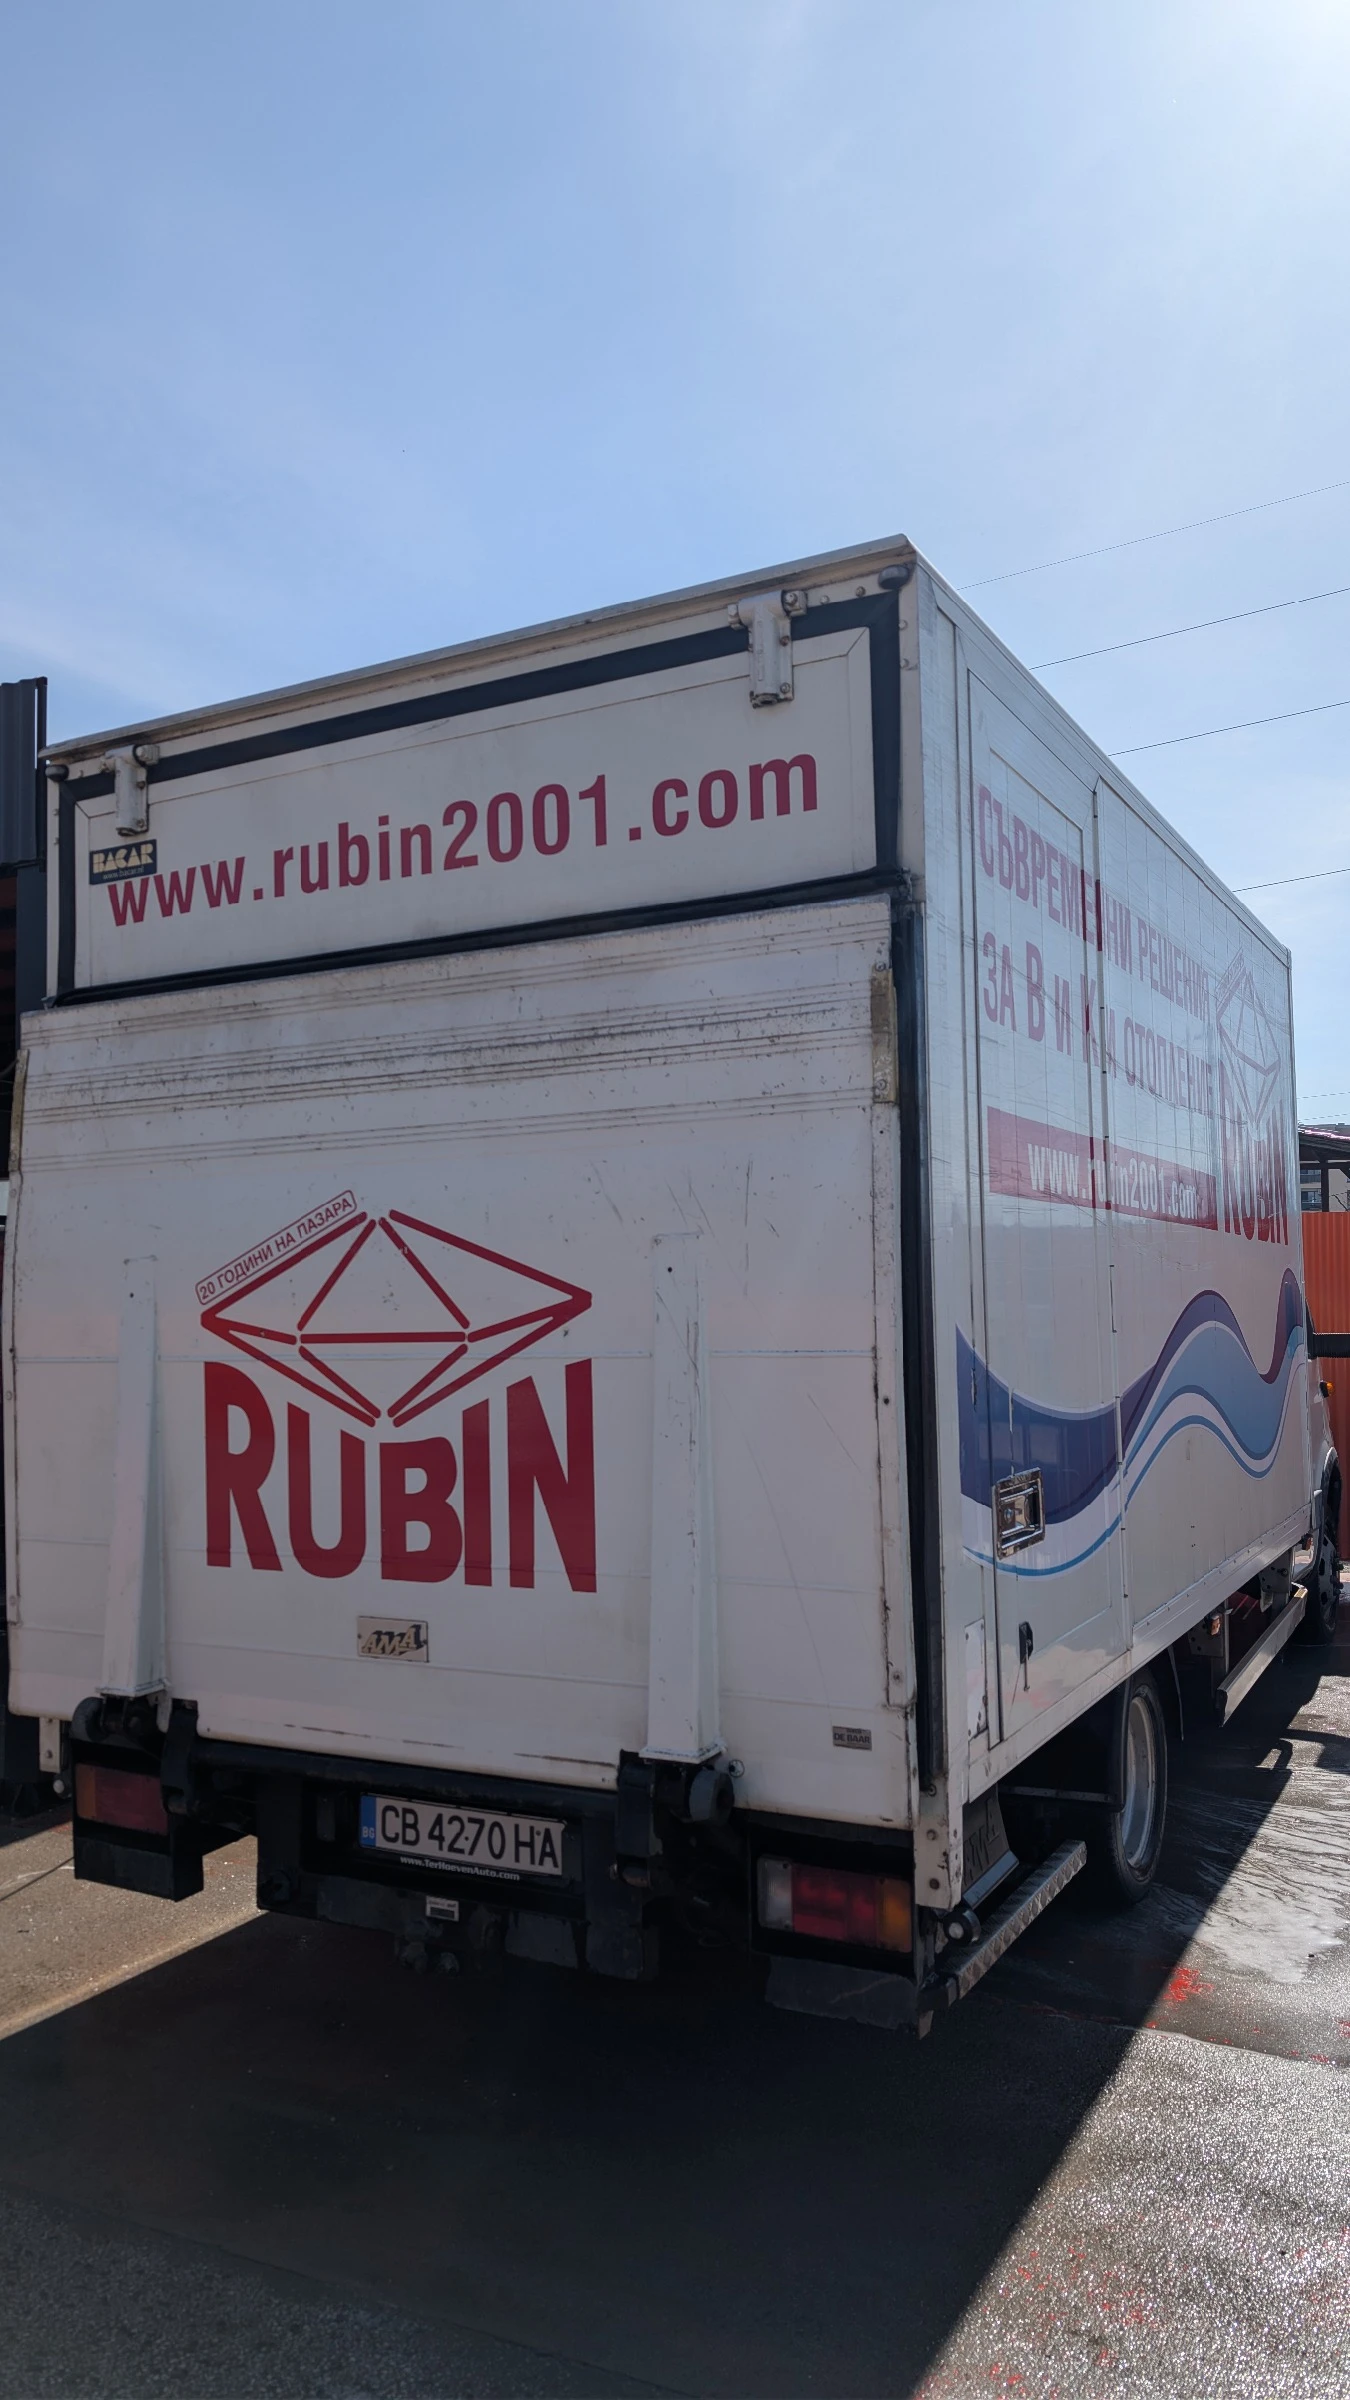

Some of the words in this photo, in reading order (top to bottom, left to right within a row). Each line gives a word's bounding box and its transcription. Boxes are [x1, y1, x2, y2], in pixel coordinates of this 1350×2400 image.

[92, 843, 154, 874] BACAR
[107, 753, 819, 927] www.rubin2001.com
[983, 932, 1017, 1032] ЗА
[200, 1281, 216, 1300] 20
[217, 1245, 274, 1288] ГОДИНИ
[275, 1232, 296, 1252] НА
[297, 1198, 352, 1238] ПАЗАРА
[204, 1358, 598, 1593] RUBIN
[362, 1826, 375, 1839] BG
[428, 1813, 506, 1860] 4270
[400, 1856, 520, 1881] www.TerHoevenAuto.com
